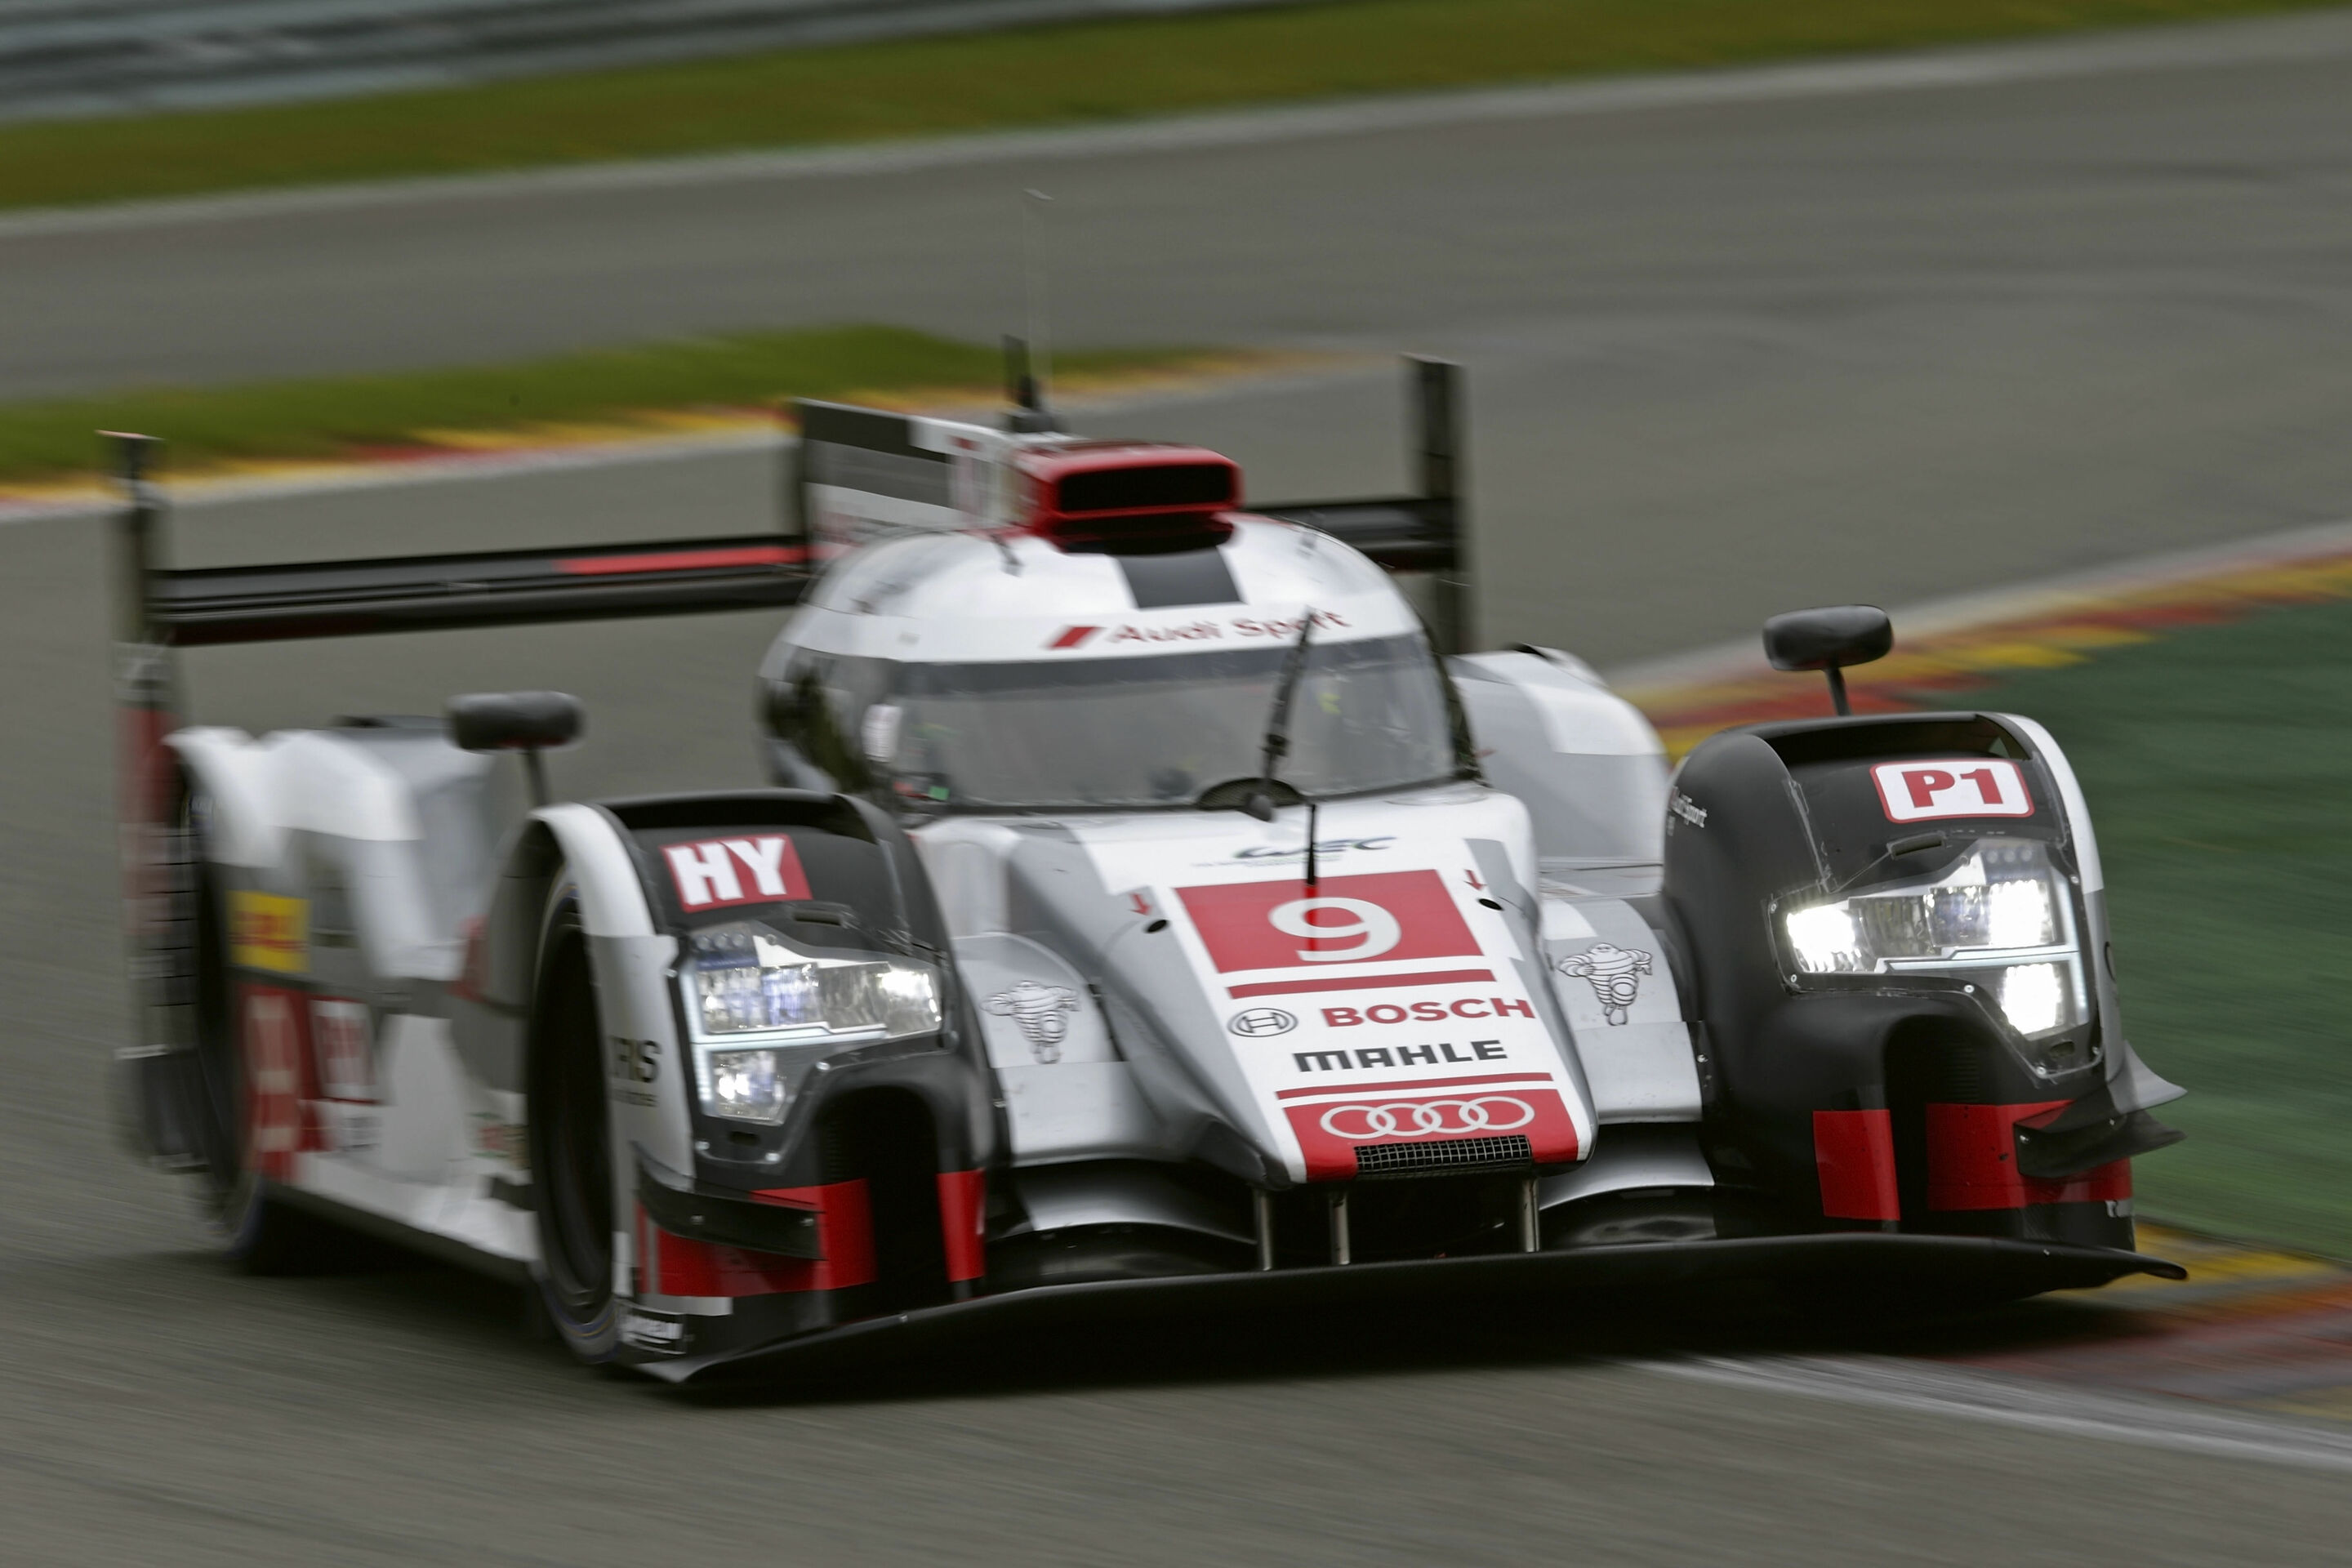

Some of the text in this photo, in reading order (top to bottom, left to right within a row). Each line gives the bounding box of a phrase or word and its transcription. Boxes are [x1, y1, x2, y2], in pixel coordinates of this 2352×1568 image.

[1106, 609, 1352, 643] Audi Sport
[1901, 768, 2003, 808] P1
[665, 836, 787, 906] HY
[1268, 897, 1402, 962] 9
[1321, 997, 1536, 1028] BOSCH
[1293, 1040, 1508, 1072] MAHLE
